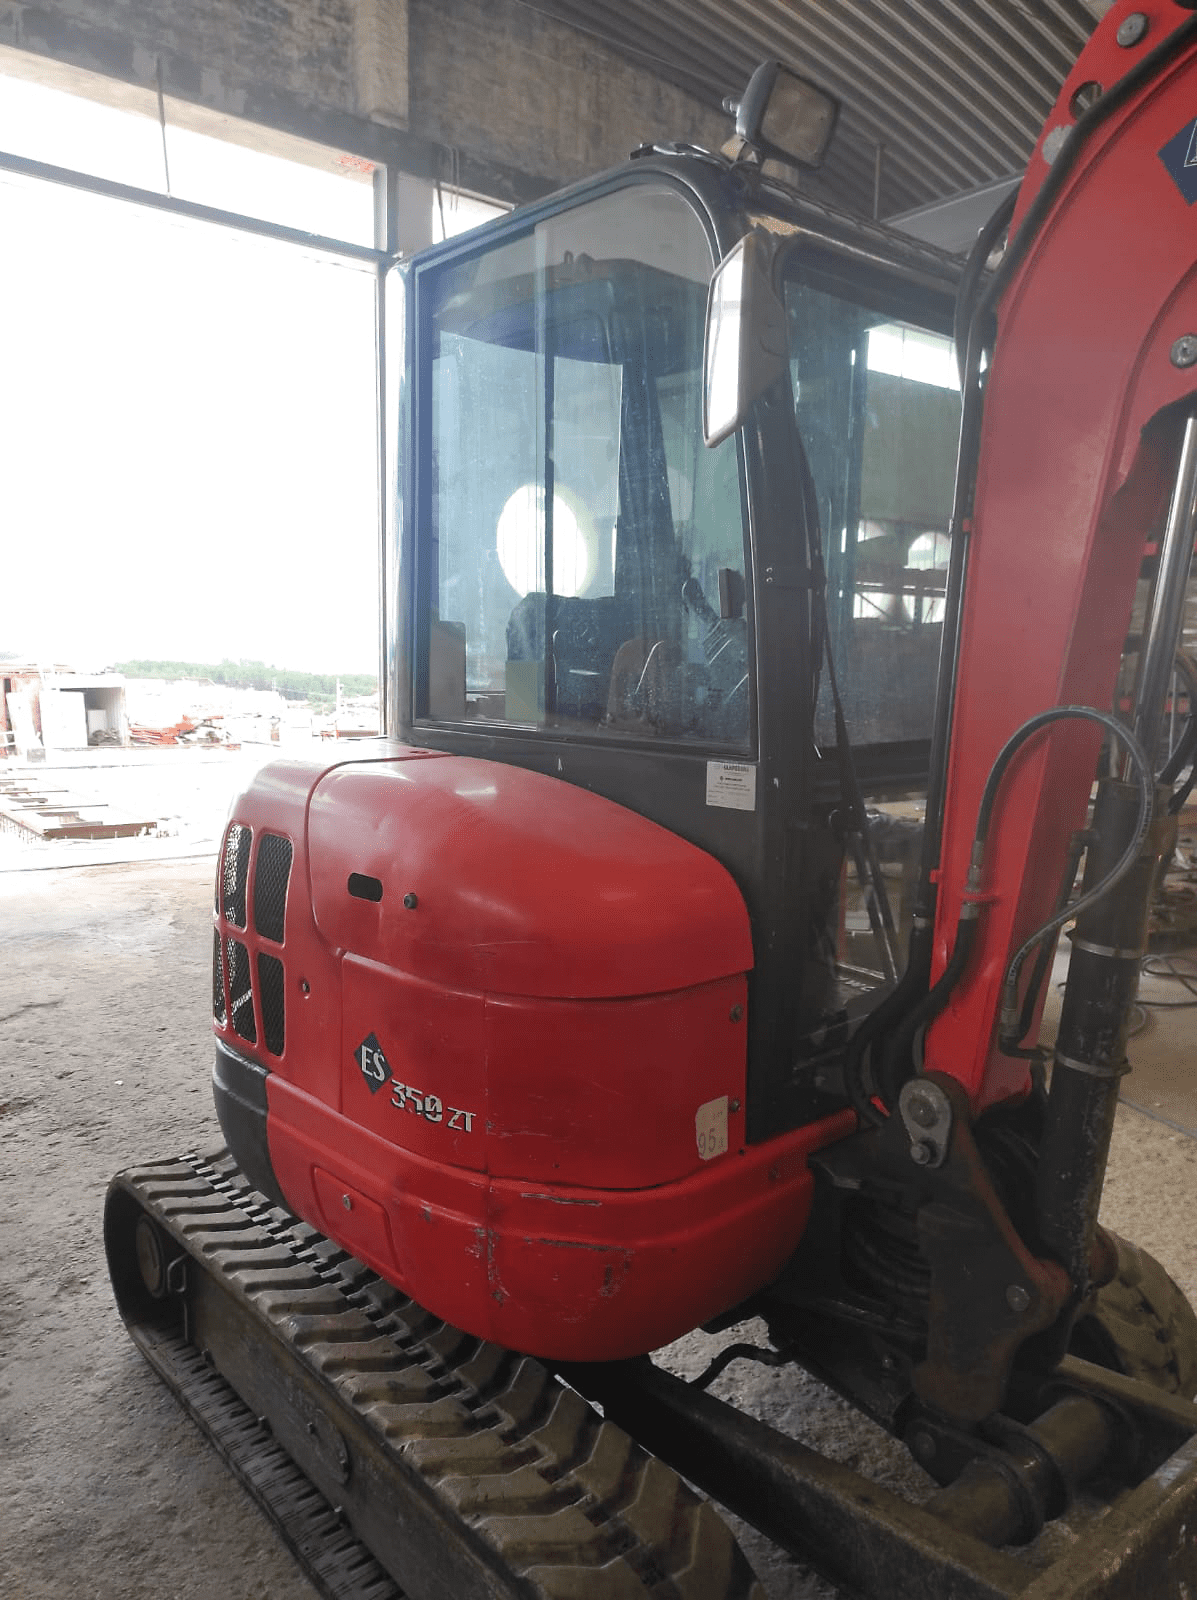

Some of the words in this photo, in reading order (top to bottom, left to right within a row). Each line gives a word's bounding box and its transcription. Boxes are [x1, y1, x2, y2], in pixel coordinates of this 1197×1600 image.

[361, 1044, 386, 1082] ES
[391, 1079, 443, 1122] 350
[447, 1106, 477, 1132] ZT
